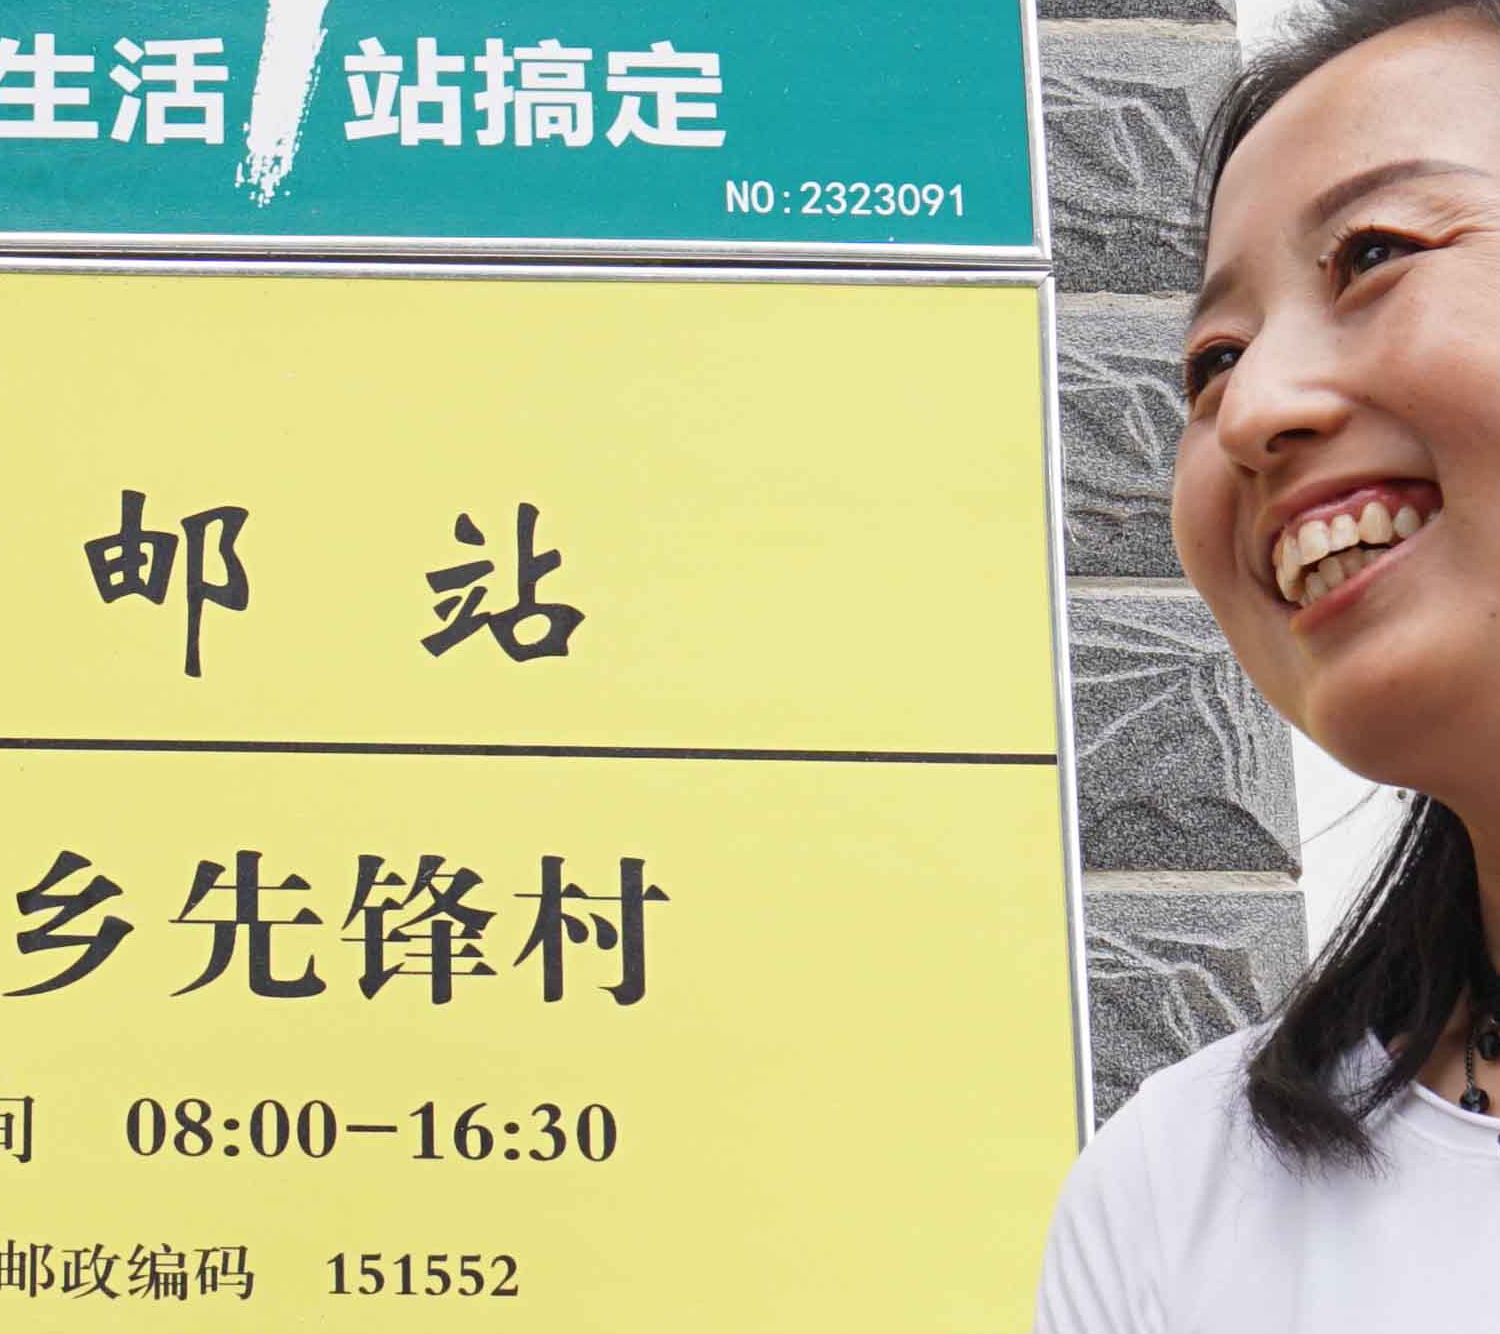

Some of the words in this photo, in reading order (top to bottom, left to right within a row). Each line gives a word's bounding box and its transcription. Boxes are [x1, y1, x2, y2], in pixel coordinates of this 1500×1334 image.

[725, 179, 965, 218] NO:2323091
[126, 1097, 618, 1164] 08:00-16:30
[326, 1252, 520, 1298] 151552
